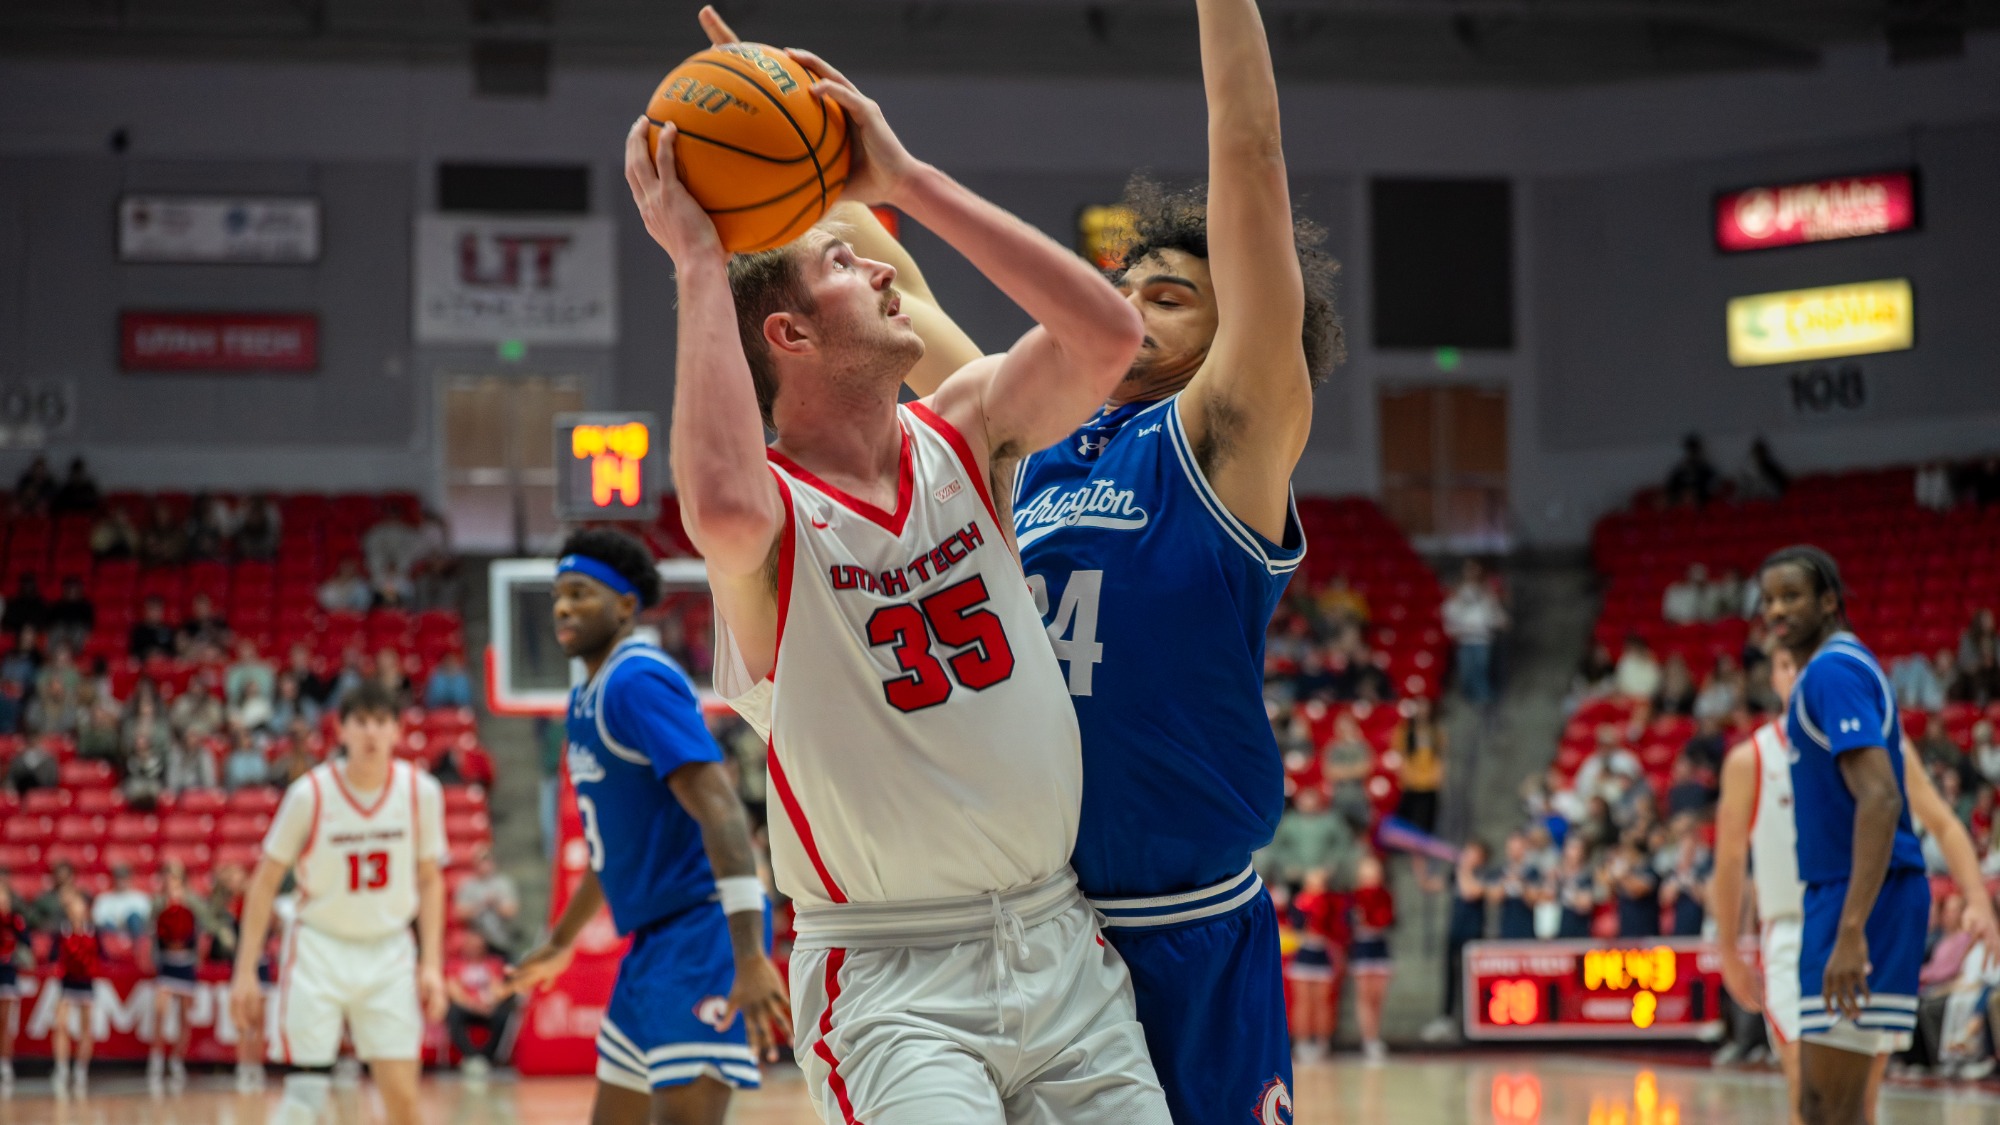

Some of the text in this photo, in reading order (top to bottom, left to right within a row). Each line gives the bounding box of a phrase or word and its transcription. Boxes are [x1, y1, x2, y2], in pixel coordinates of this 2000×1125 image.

[829, 521, 985, 597] UTAH TECH
[865, 573, 1015, 714] 35
[347, 850, 390, 893] 13
